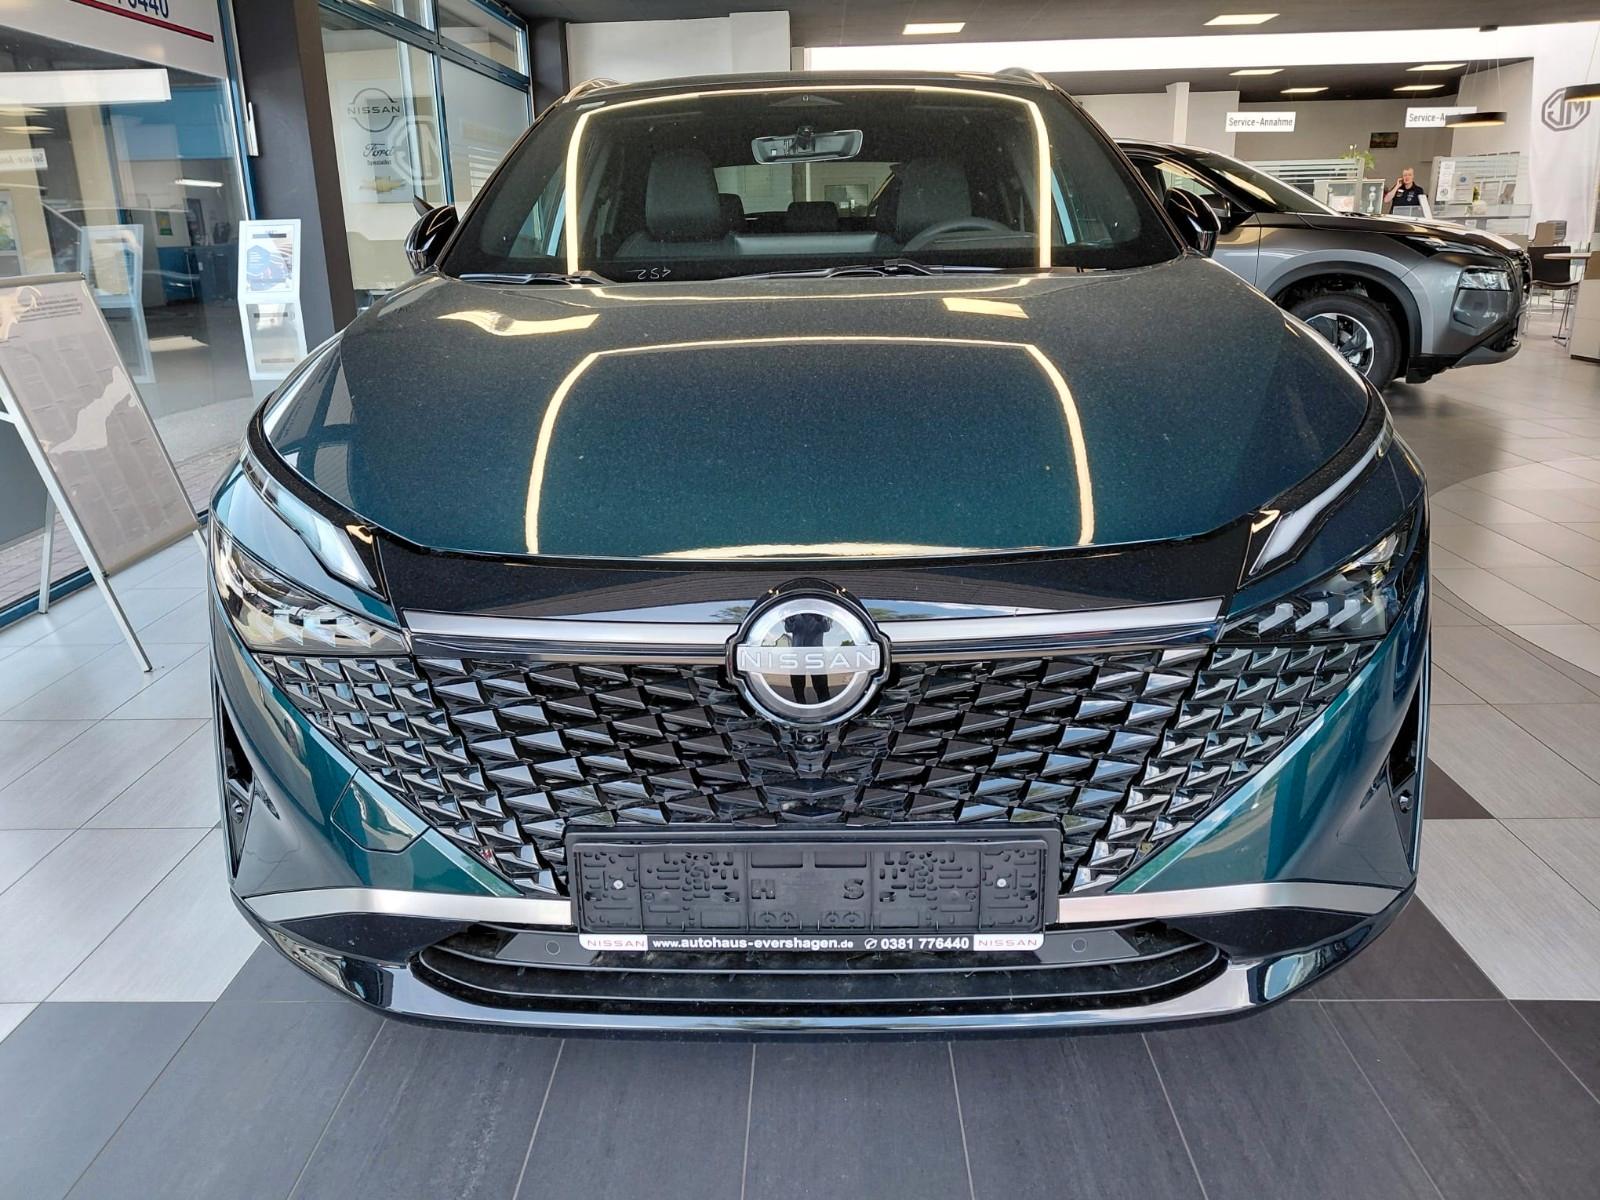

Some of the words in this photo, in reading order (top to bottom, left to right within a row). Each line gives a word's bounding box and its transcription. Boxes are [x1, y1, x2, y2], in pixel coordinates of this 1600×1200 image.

[347, 106, 401, 114] NISSAN
[1228, 117, 1294, 126] Service-Annahme
[1409, 113, 1445, 122] Service-A
[363, 143, 394, 157] Ford
[740, 649, 877, 670] NISSAN
[587, 939, 645, 947] NISSAN
[652, 937, 854, 950] www.autohaus-evershagen.de
[880, 937, 913, 949] 0381
[918, 937, 970, 949] 776440
[978, 939, 1038, 947] NISSAN
